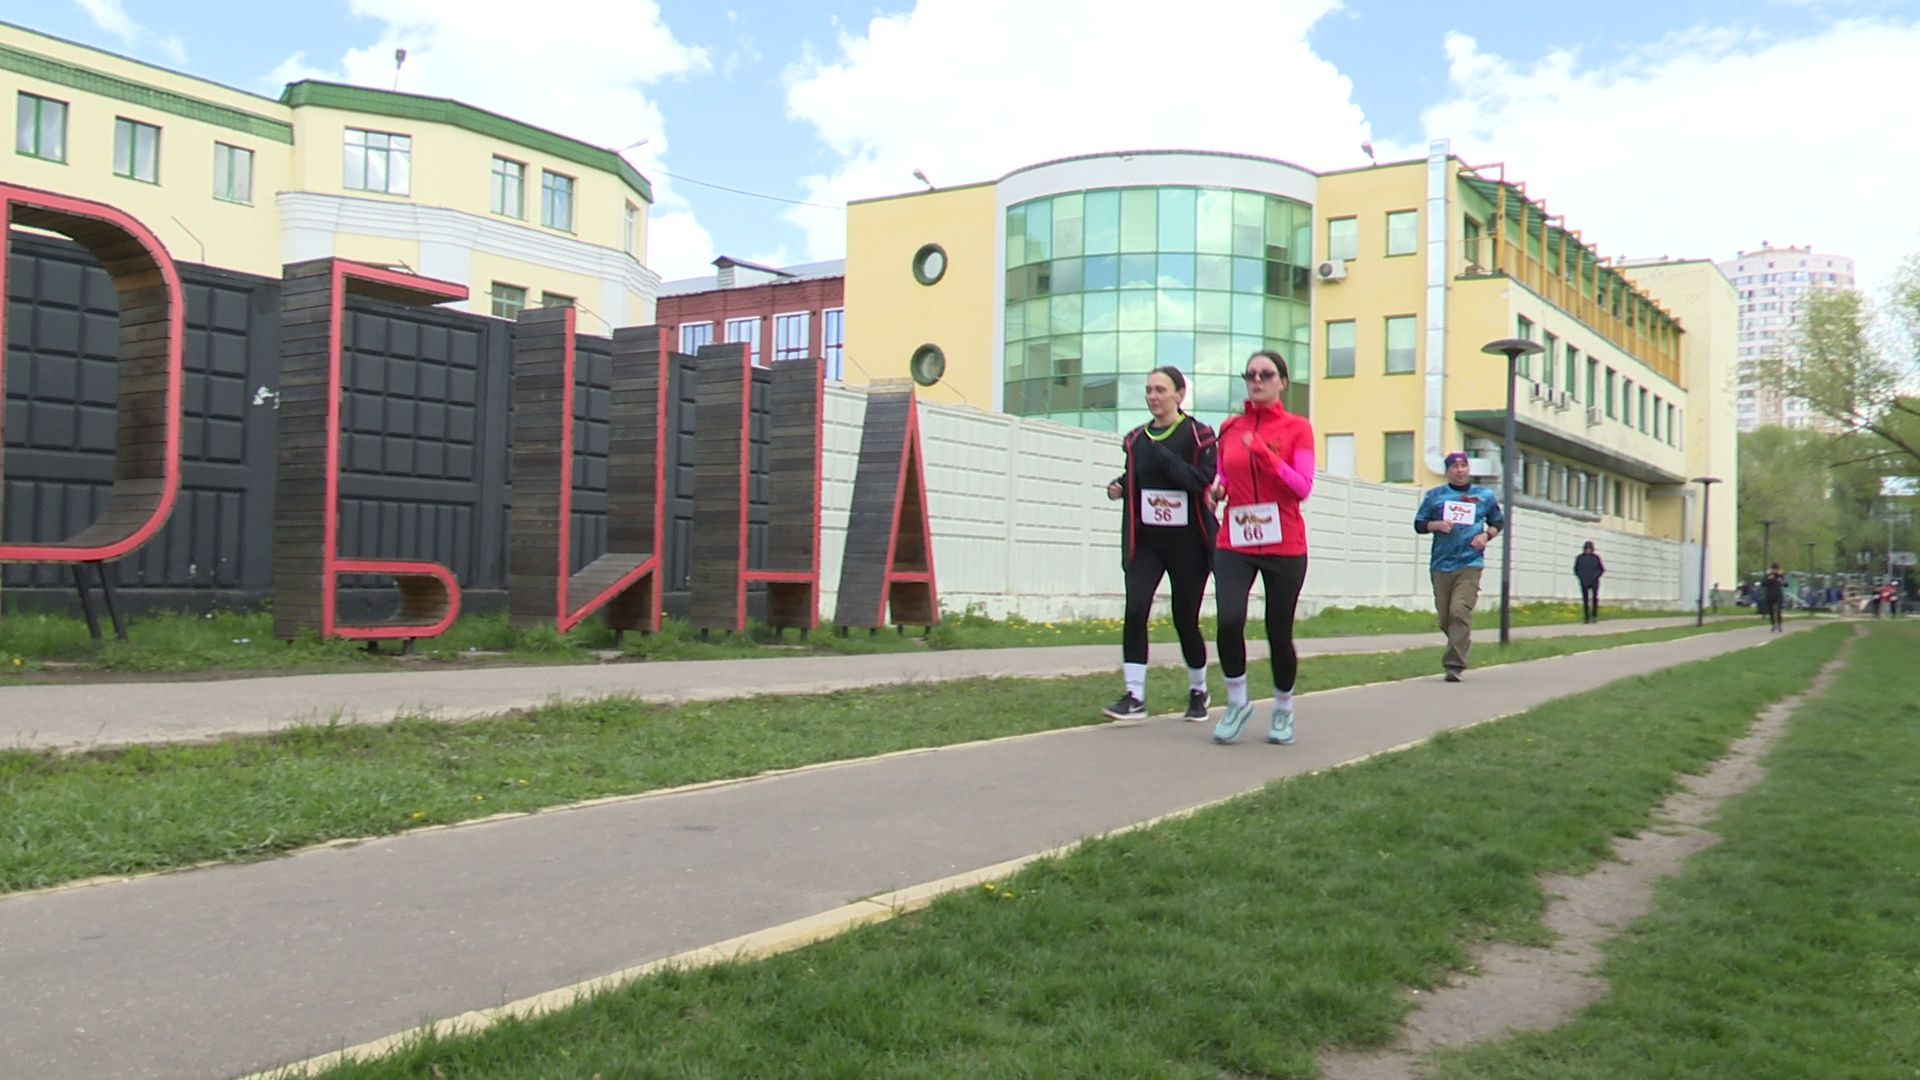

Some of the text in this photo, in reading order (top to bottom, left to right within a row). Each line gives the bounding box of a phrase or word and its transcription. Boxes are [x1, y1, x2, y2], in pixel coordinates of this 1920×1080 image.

[1154, 508, 1172, 522] 56
[1452, 512, 1465, 521] 27
[1243, 525, 1264, 541] 66
